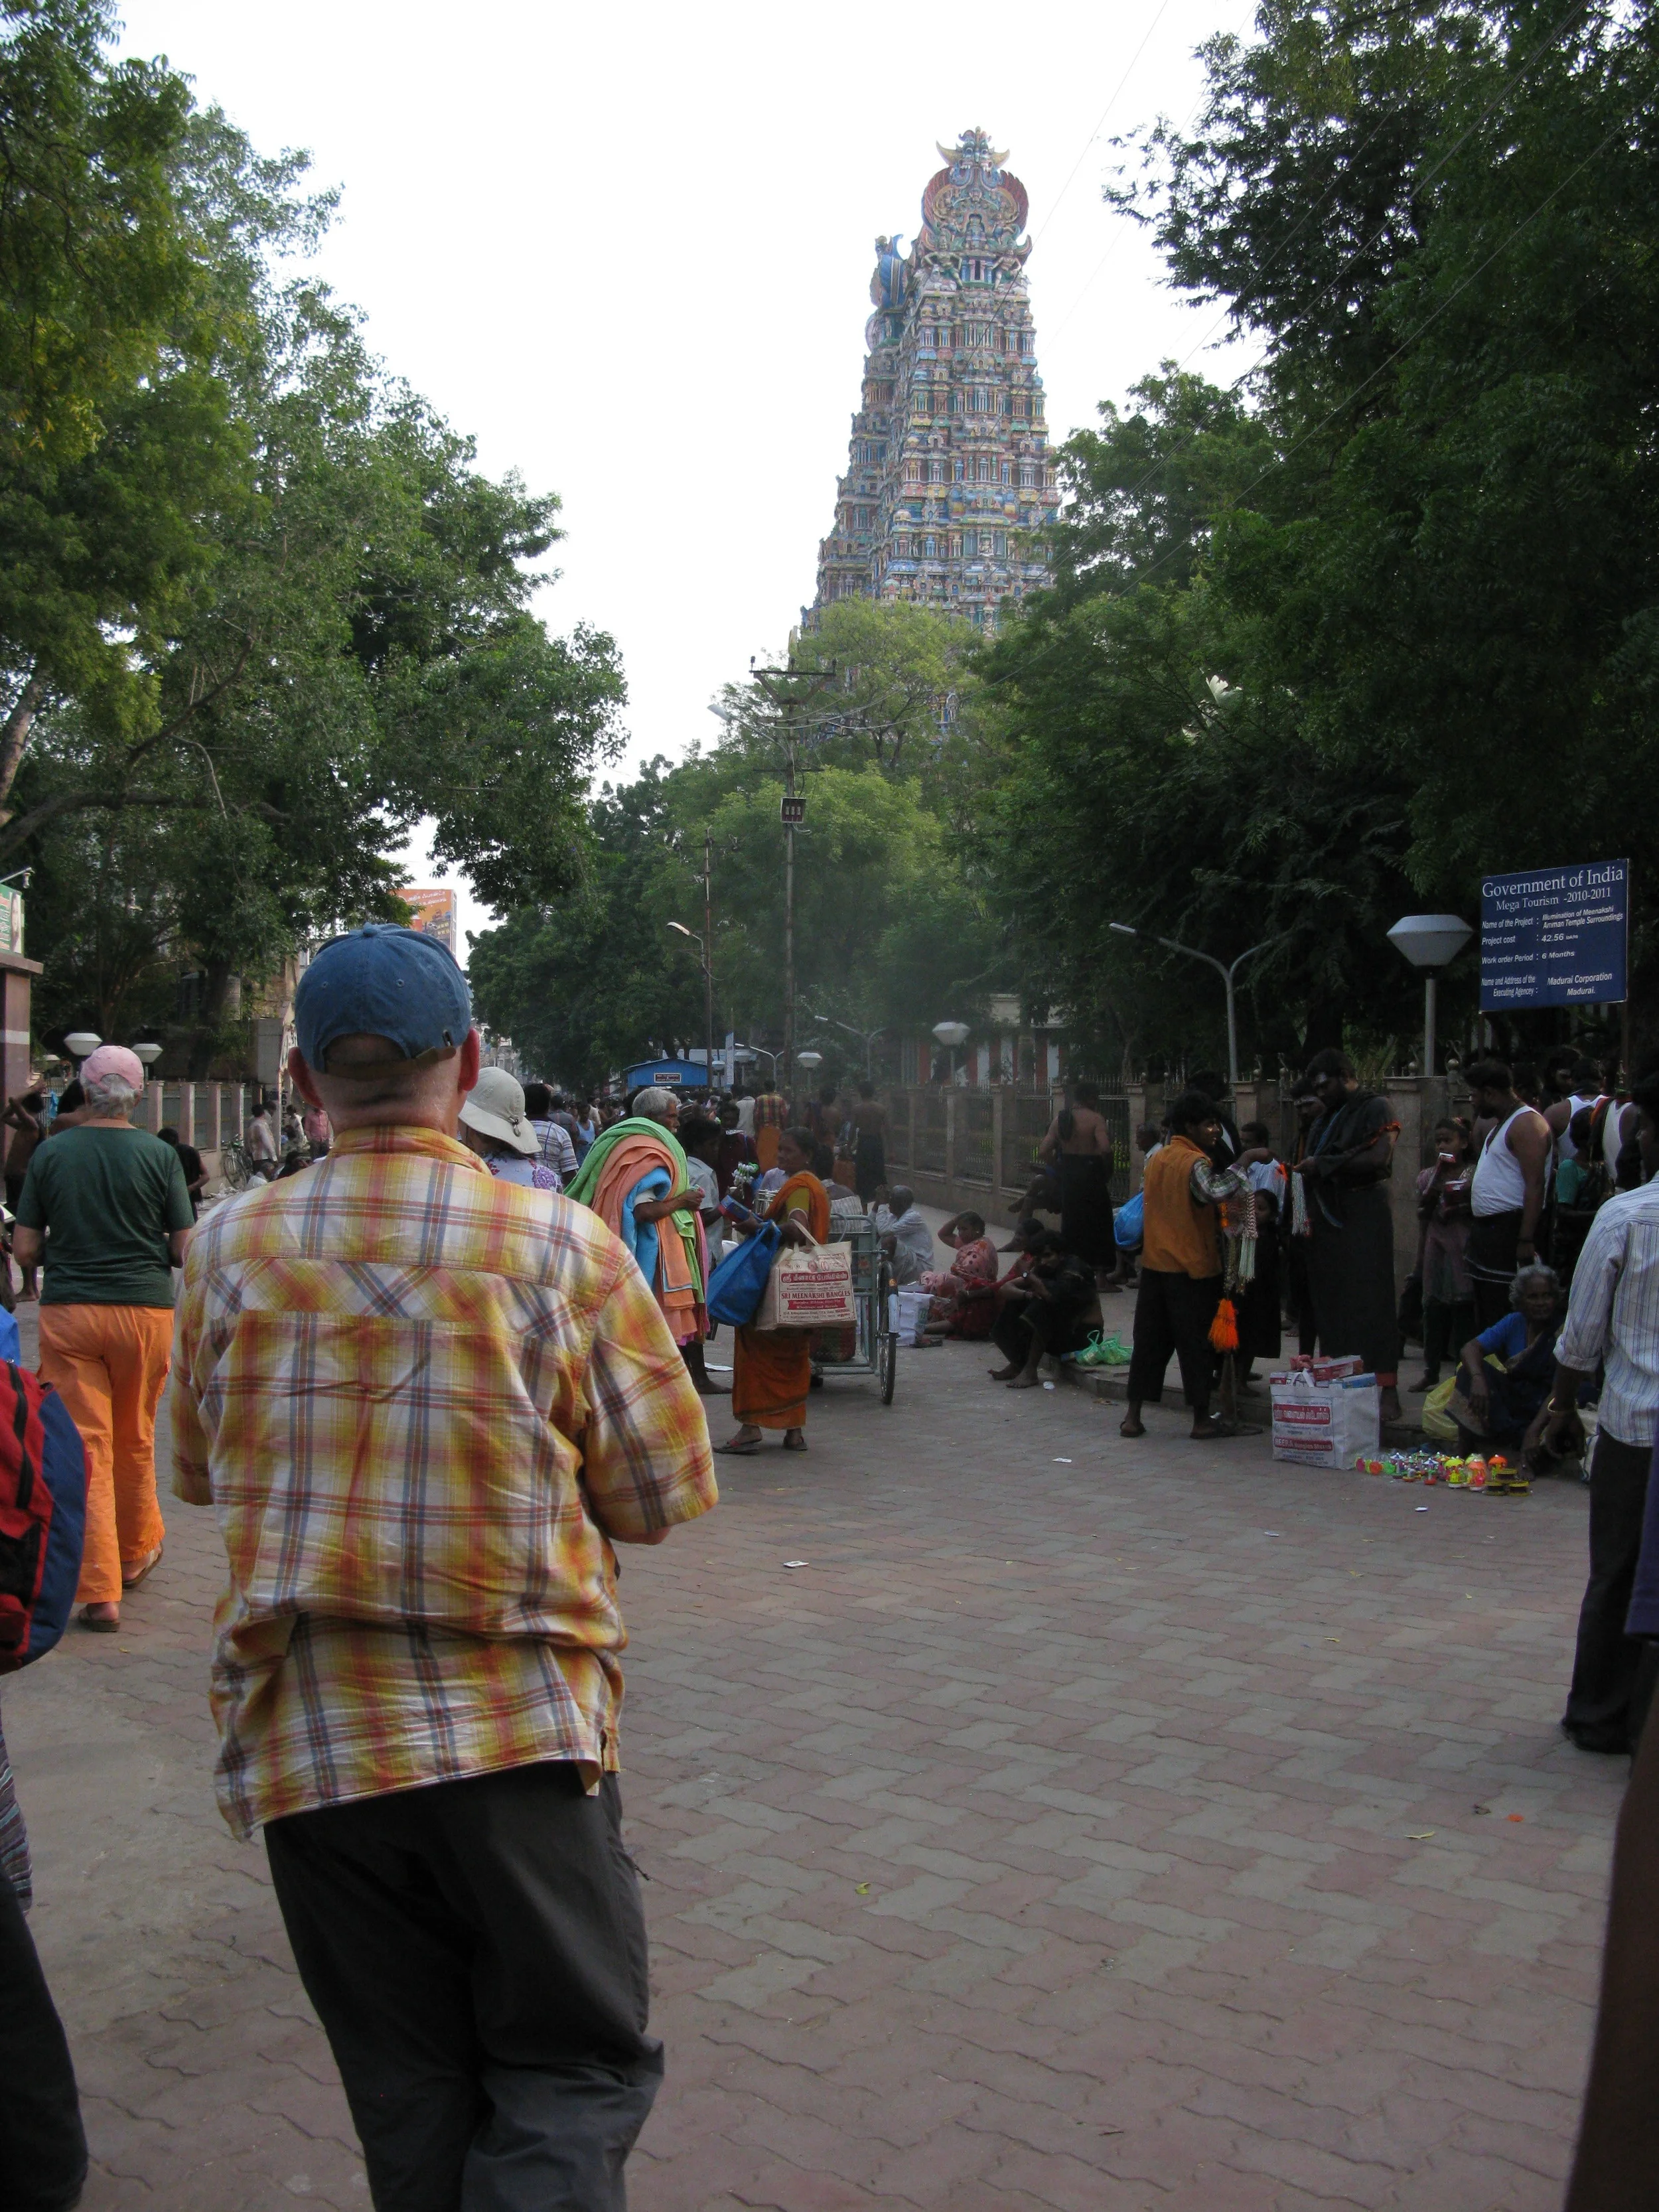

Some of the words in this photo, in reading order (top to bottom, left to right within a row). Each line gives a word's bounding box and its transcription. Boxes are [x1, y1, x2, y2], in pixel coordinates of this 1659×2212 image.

[1482, 875, 1565, 897] Government
[1569, 870, 1584, 887] of
[1587, 865, 1623, 885] India
[1496, 900, 1520, 913] Mega
[1522, 896, 1559, 909] Tourism
[1563, 887, 1611, 903] -2010-2011
[1542, 912, 1575, 921] Illumination
[1583, 905, 1614, 916] Meenakshi
[1498, 919, 1505, 928] of
[1504, 919, 1514, 927] the
[1514, 917, 1534, 928] Project
[1565, 918, 1586, 926] Temple
[1586, 913, 1624, 924] Surroundings
[1482, 936, 1502, 946] Project
[1541, 933, 1565, 942] 42.56
[1514, 954, 1534, 962] Period
[1494, 977, 1504, 986] and
[1504, 976, 1522, 985] Address
[1522, 975, 1528, 984] of
[1528, 974, 1536, 983] the
[1547, 976, 1573, 986] Madurai
[1574, 972, 1613, 984] Corporation
[1493, 988, 1514, 997] Executing
[1567, 986, 1595, 995] Madurai.
[826, 1290, 851, 1298] BANGLES
